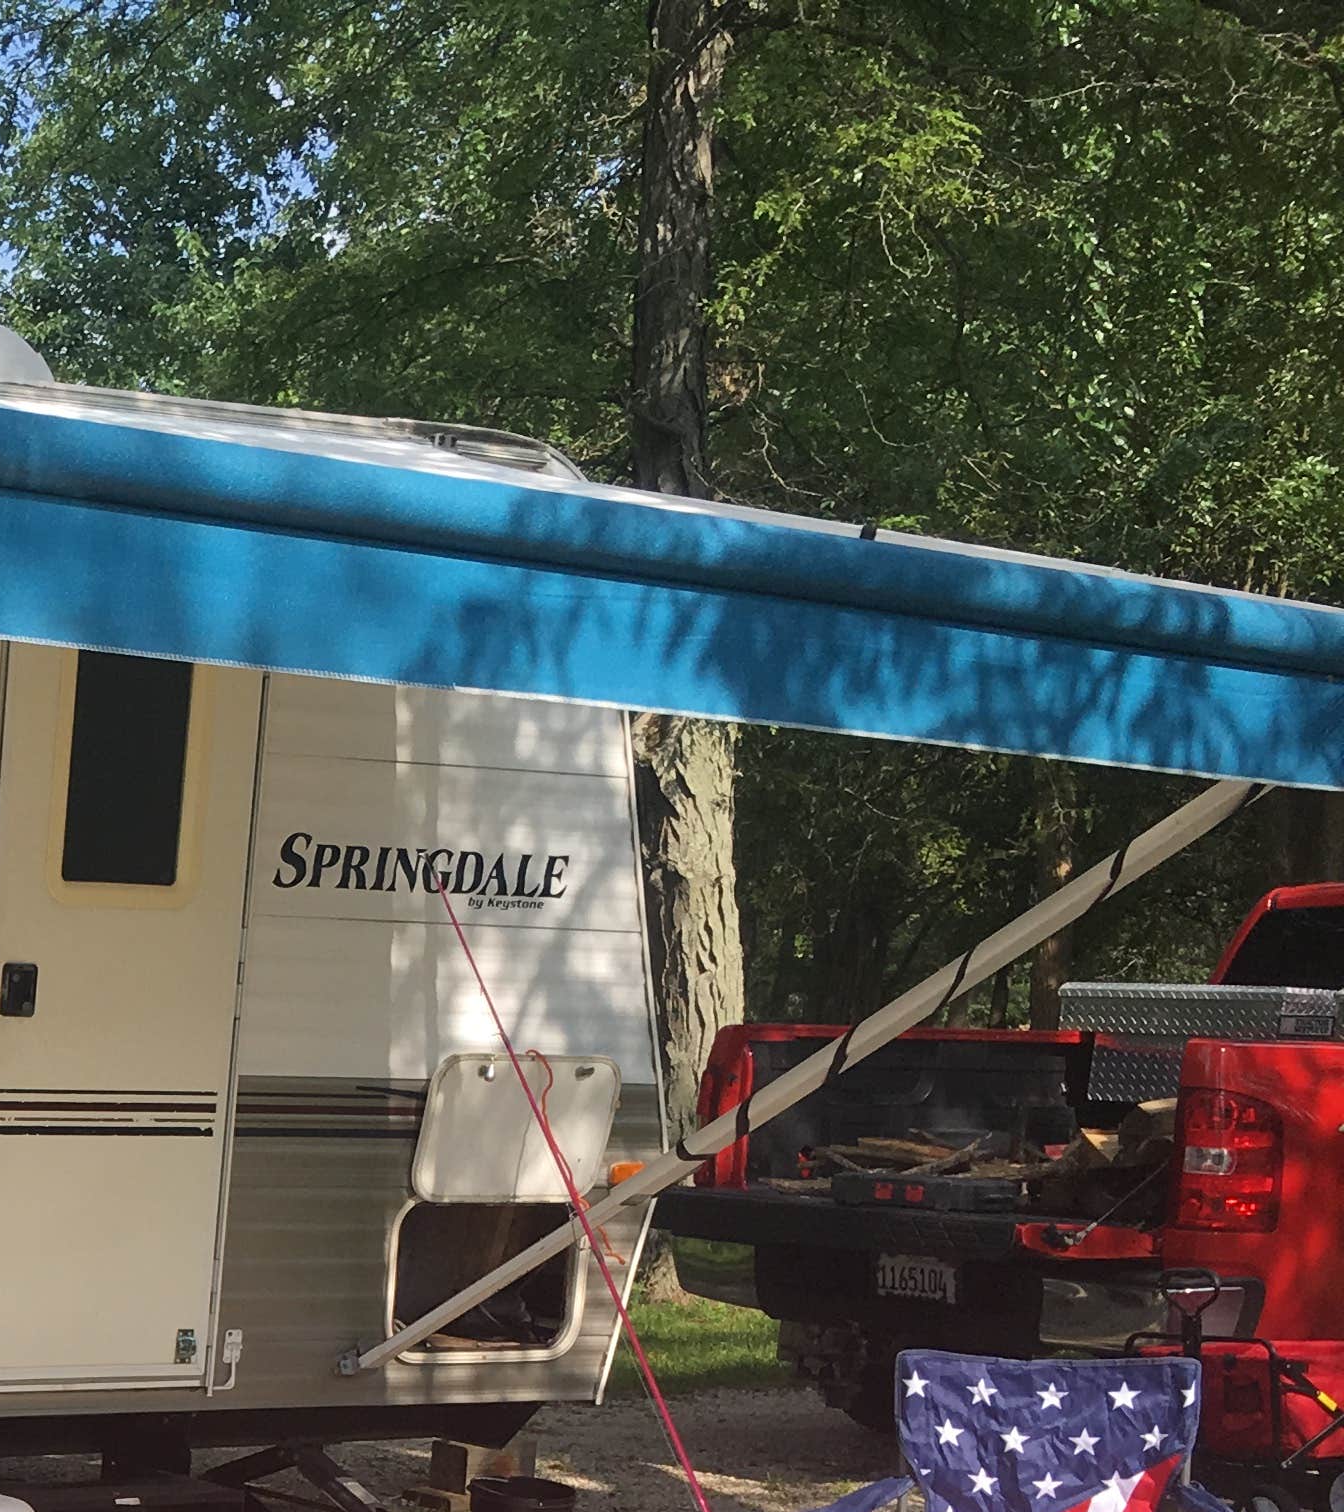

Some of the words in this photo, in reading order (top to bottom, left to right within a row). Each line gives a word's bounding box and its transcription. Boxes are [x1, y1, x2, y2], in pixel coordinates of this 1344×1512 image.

[272, 831, 570, 899] SPRINGDALE
[467, 896, 484, 910] by
[487, 898, 545, 911] Keystone
